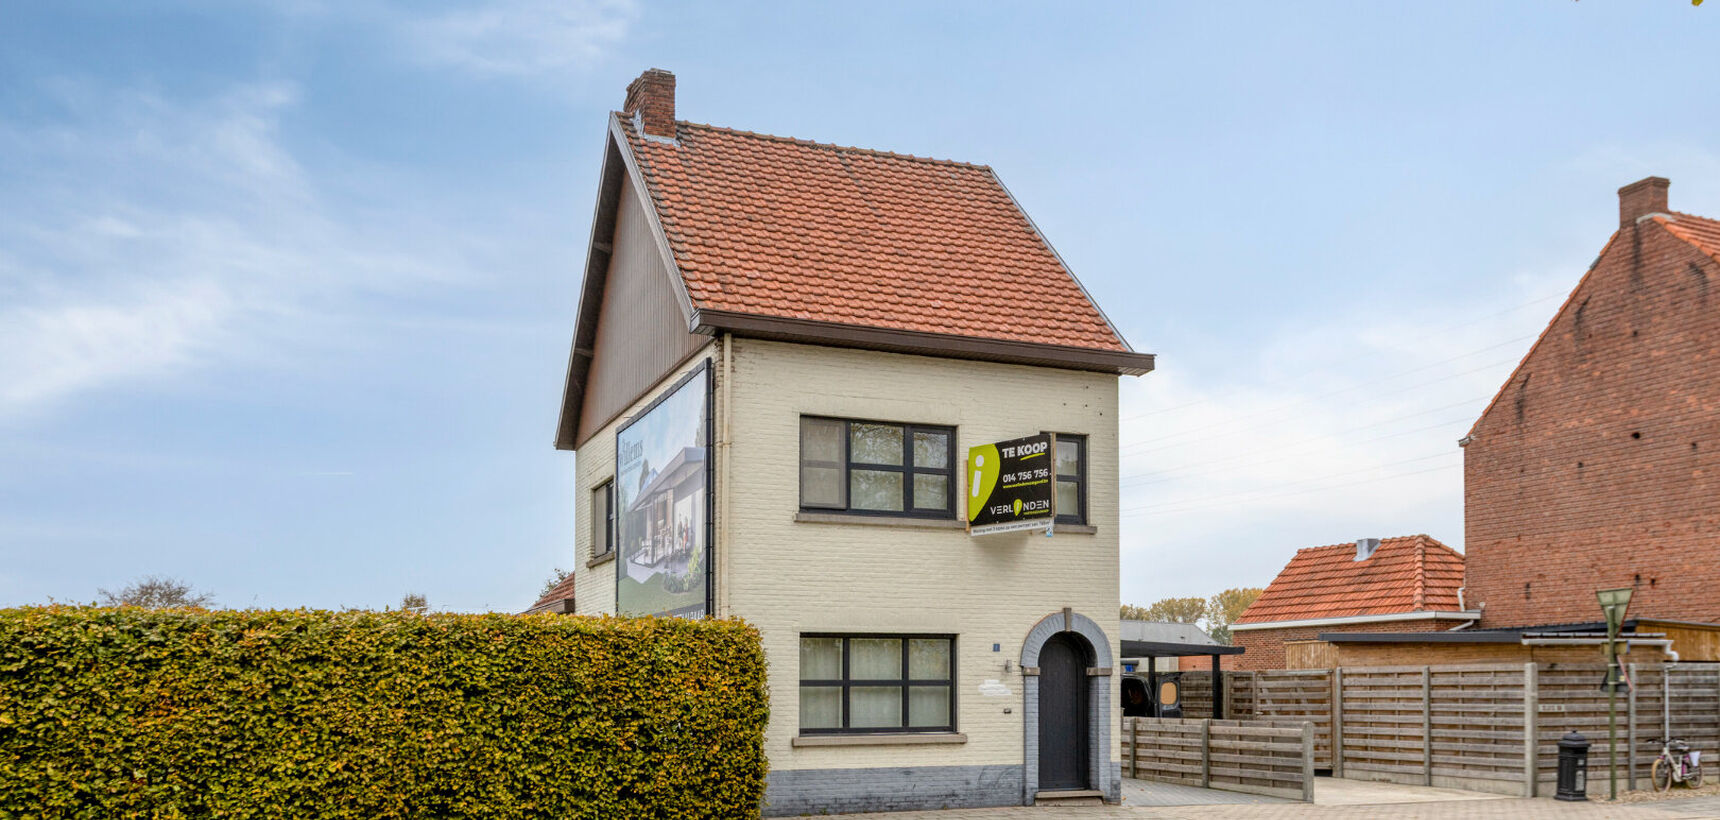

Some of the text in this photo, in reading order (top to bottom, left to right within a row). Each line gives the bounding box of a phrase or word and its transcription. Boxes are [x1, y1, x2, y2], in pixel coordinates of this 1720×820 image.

[1002, 442, 1047, 458] TE KOOP
[1003, 468, 1048, 483] 014 756 756
